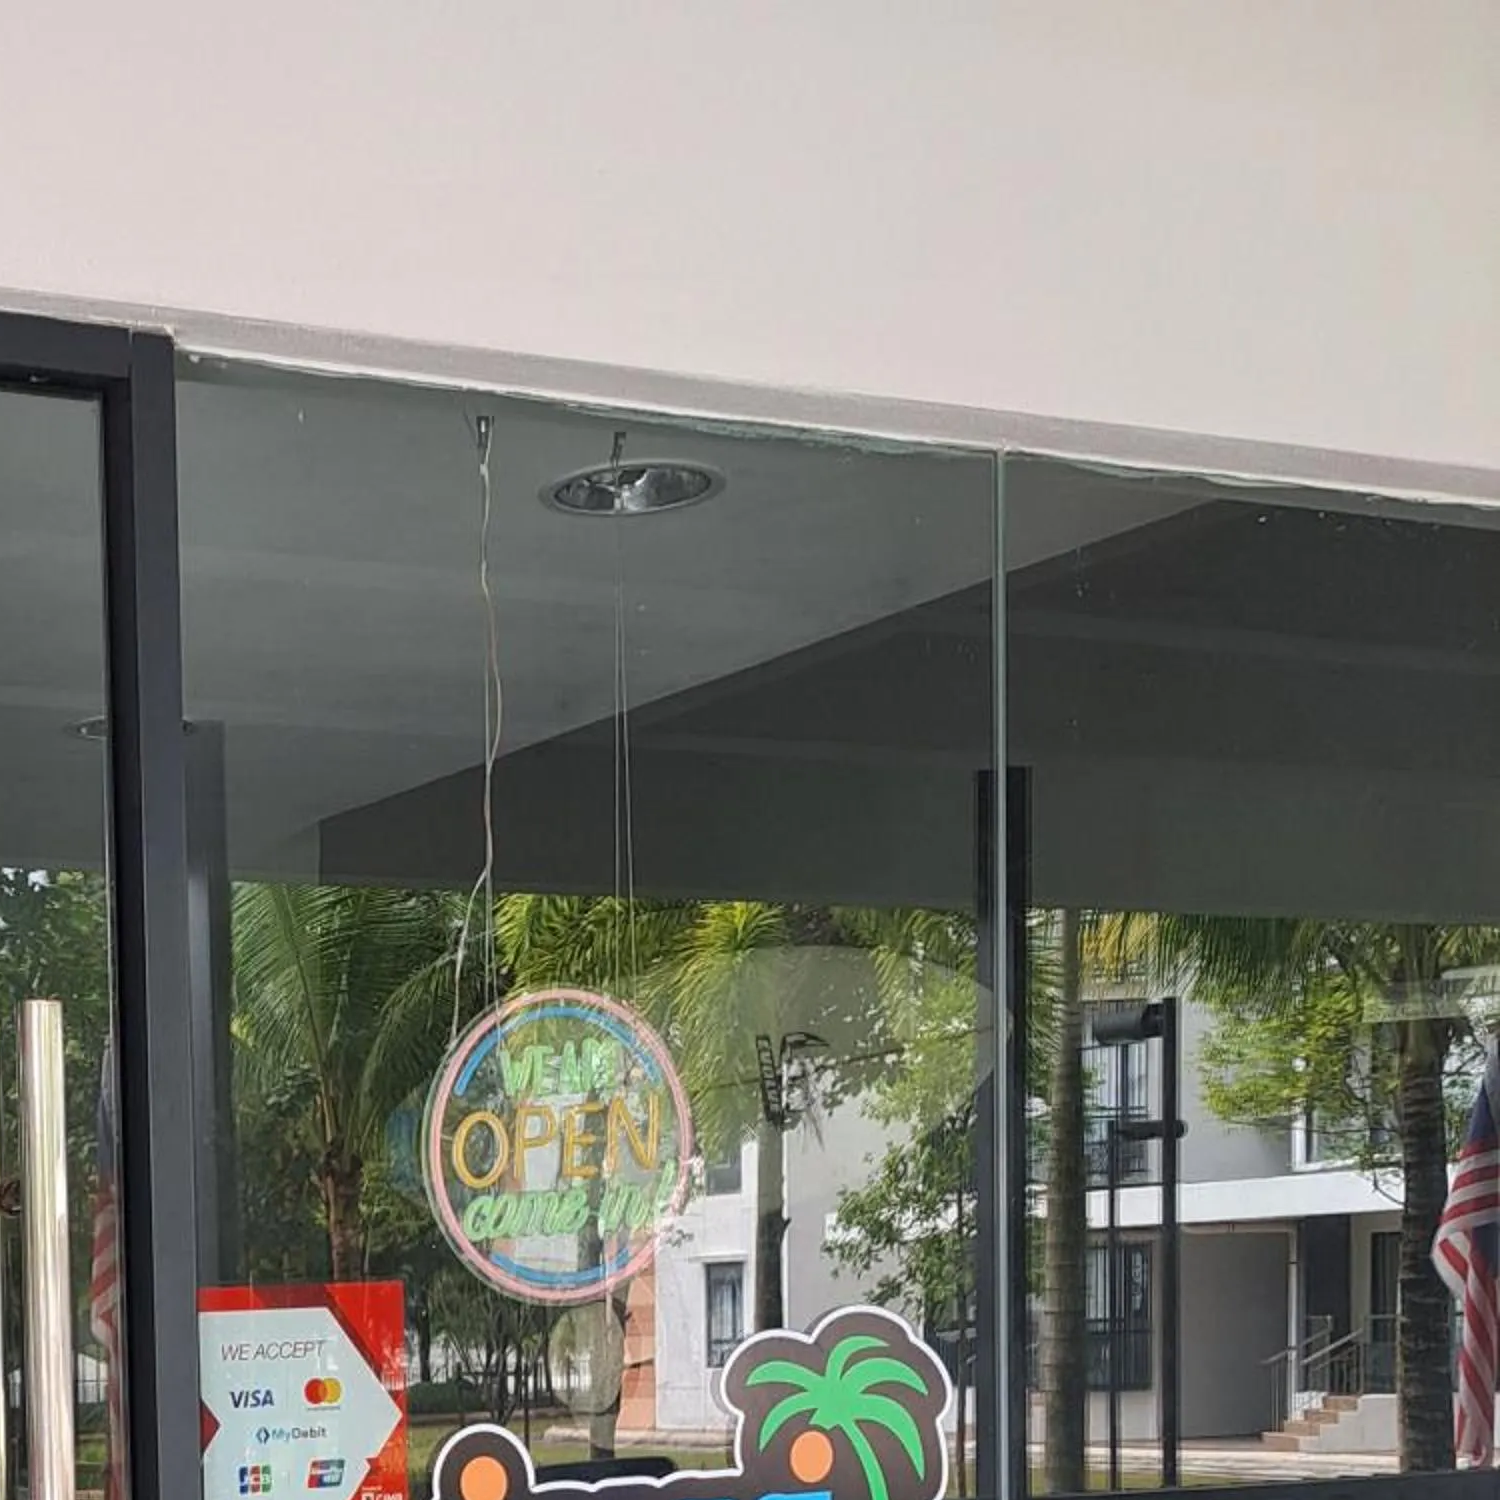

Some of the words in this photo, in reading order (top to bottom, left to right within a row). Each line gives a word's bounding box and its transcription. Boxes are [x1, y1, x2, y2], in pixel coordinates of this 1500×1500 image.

[452, 1093, 660, 1190] OPEN
[221, 1343, 251, 1361] WE
[252, 1340, 328, 1361] ACCEPT
[229, 1389, 275, 1409] VISA
